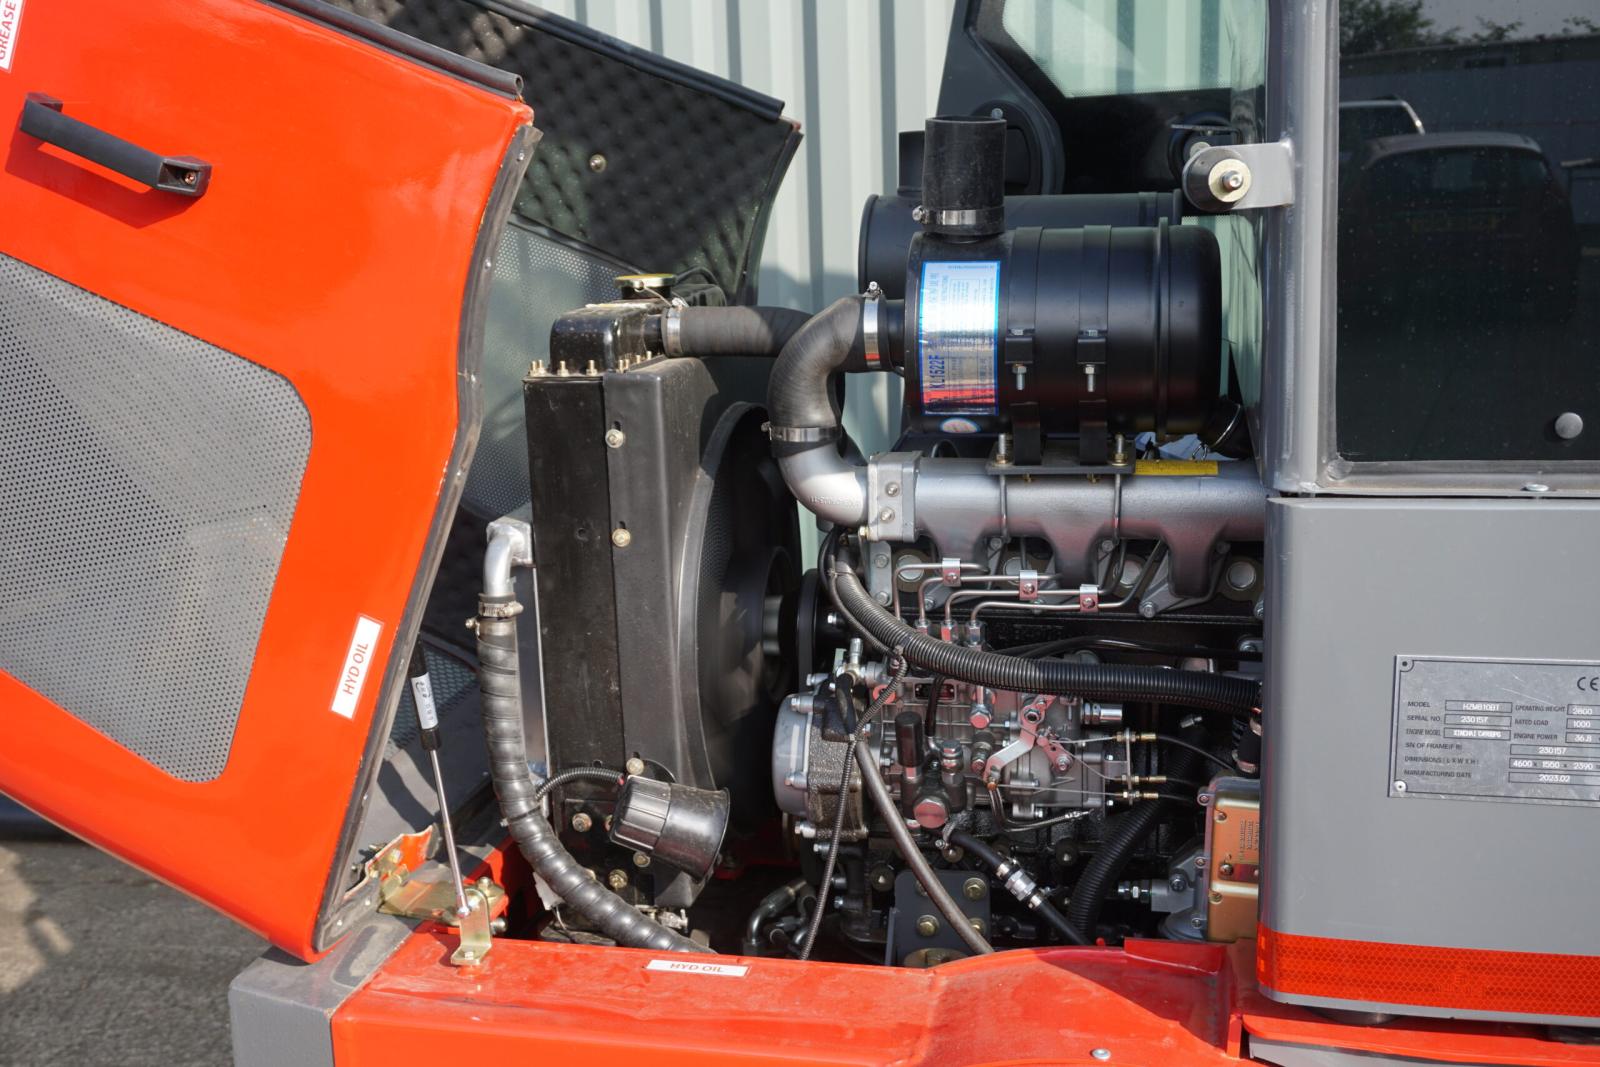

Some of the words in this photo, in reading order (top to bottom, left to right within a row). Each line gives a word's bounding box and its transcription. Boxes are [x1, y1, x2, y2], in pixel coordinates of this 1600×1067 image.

[929, 355, 945, 389] KL1522F
[342, 666, 361, 695] HYD
[353, 643, 369, 664] OIL
[1577, 676, 1599, 691] CE
[1460, 716, 1489, 724] 230157
[1539, 774, 1570, 782] 2023.02
[670, 963, 699, 971] HYD
